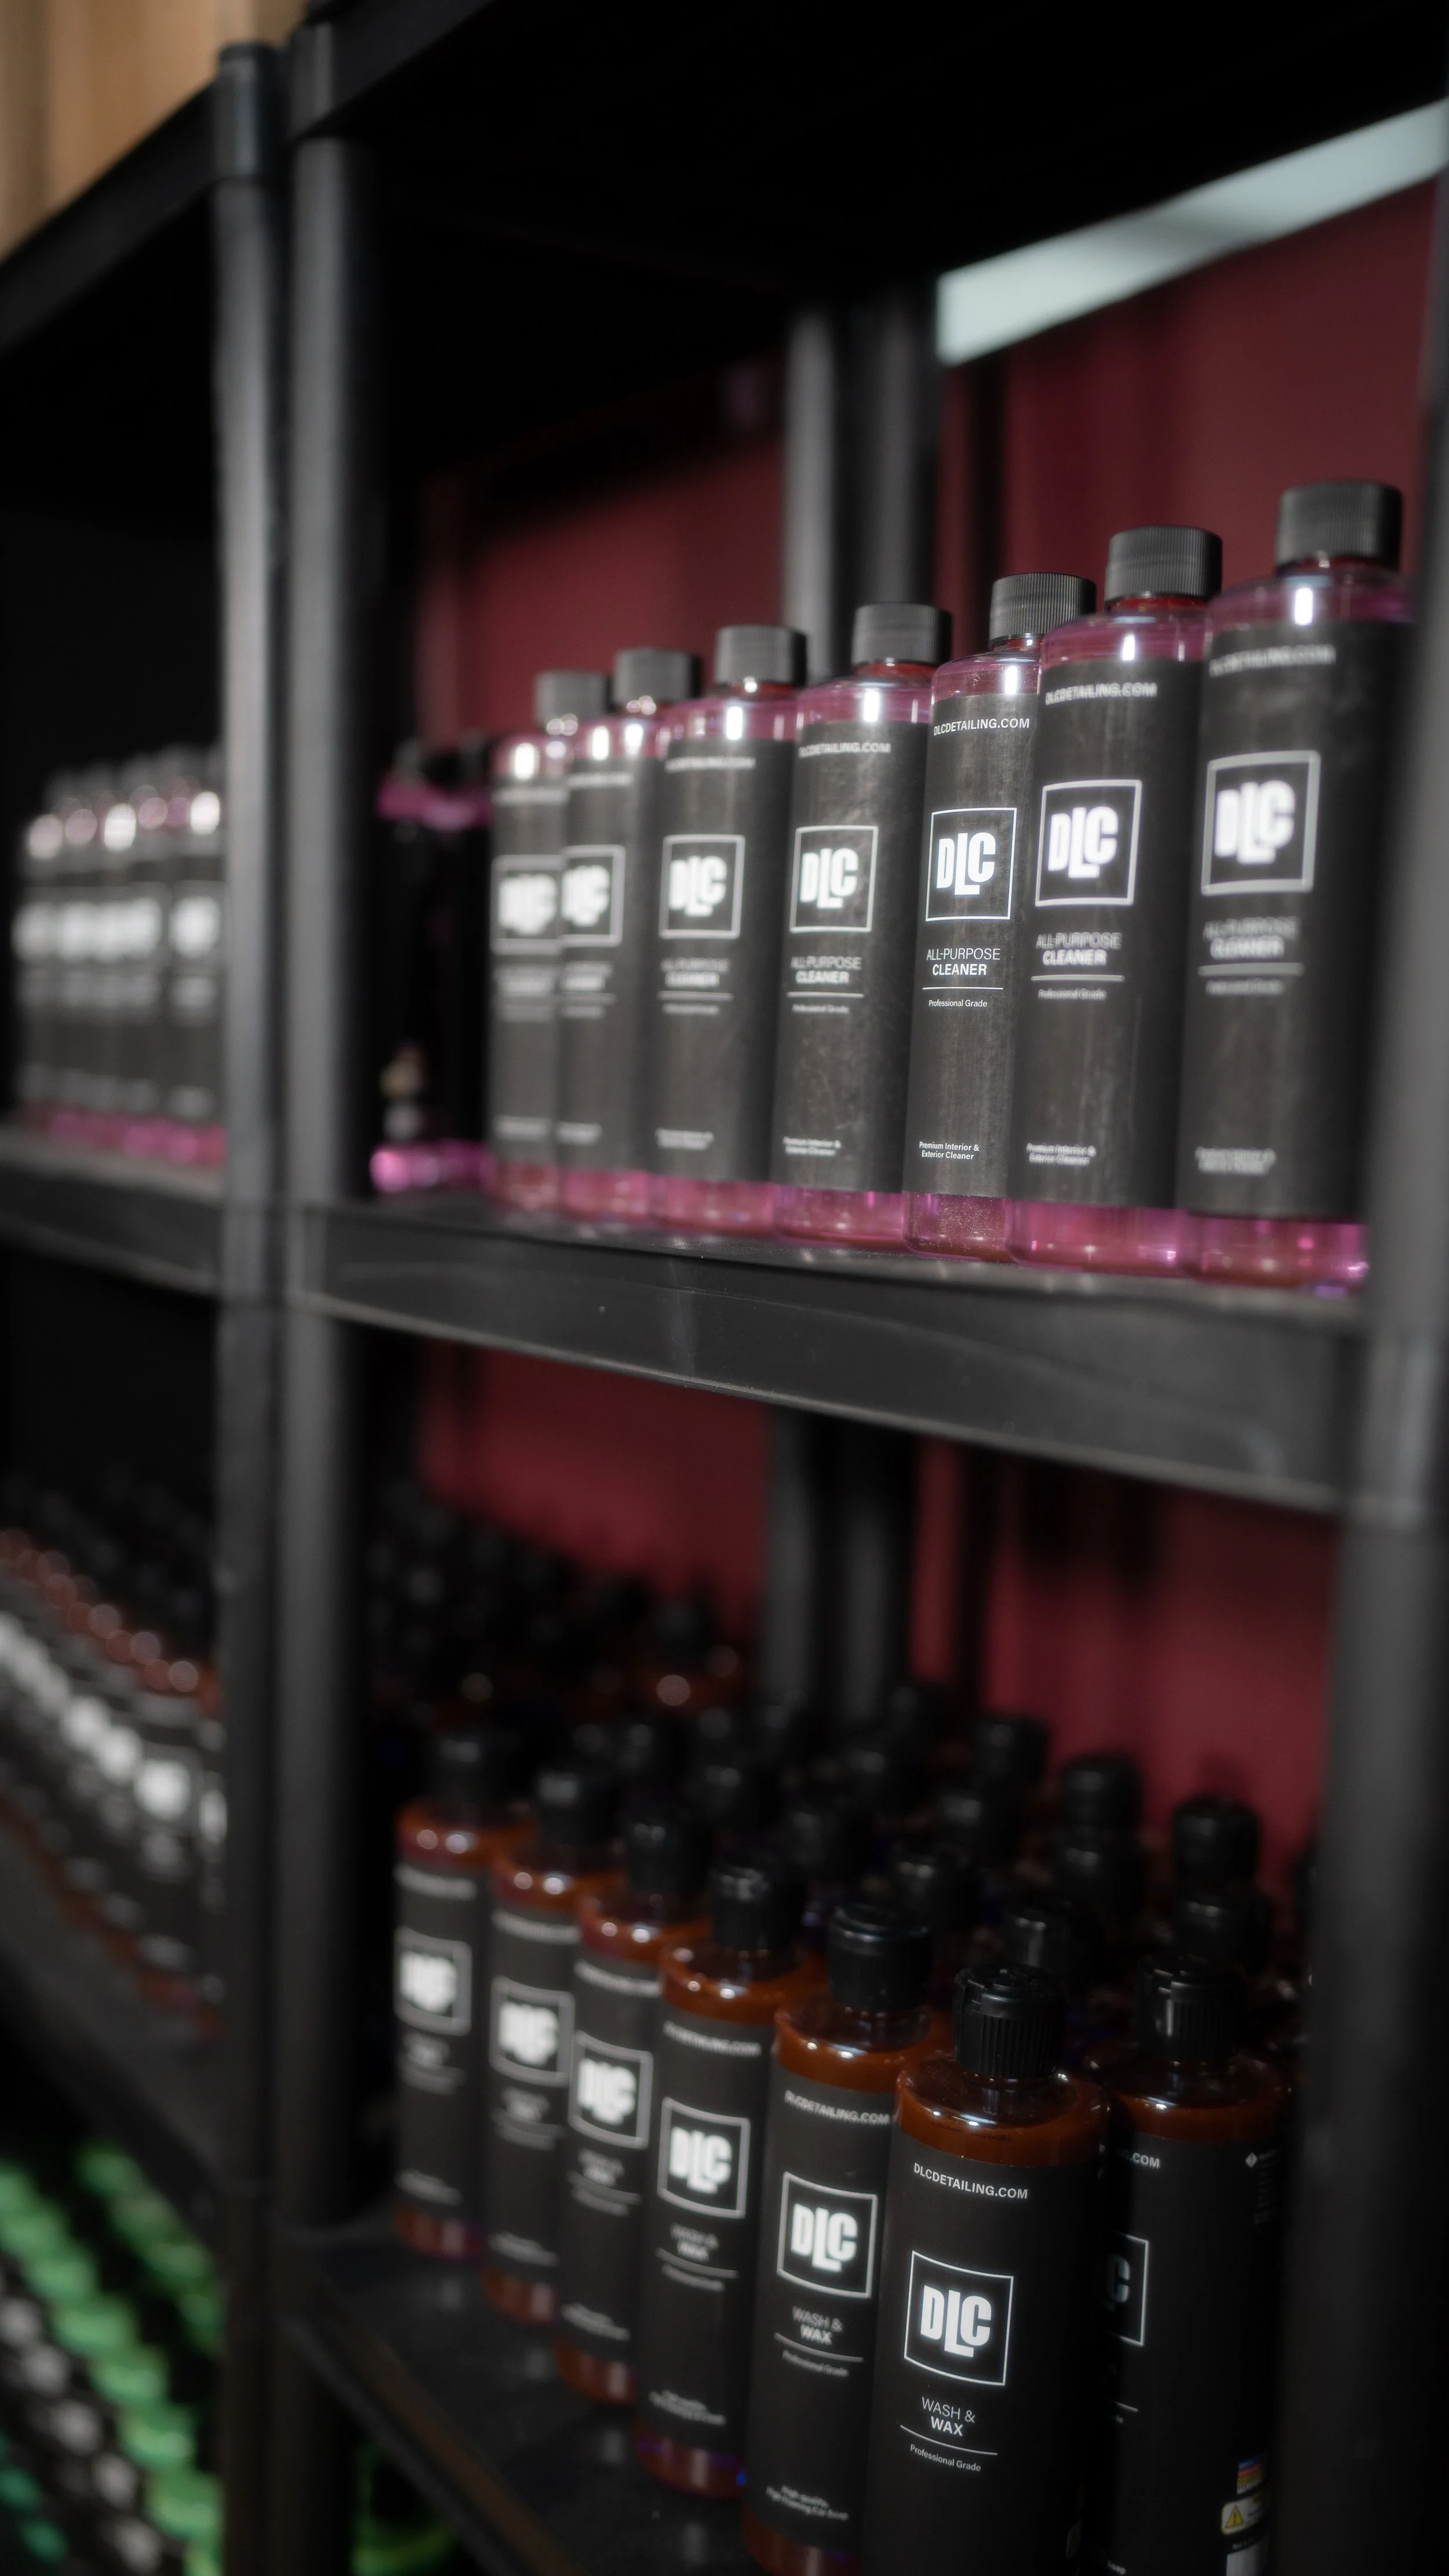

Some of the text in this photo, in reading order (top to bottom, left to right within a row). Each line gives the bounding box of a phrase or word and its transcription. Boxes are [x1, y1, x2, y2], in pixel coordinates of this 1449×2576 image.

[1046, 682, 1158, 705] DLCDETAILING.COM
[934, 718, 1030, 736] DLCDETAILING.COM
[1214, 780, 1295, 864] DLC
[1048, 806, 1119, 878] DLC
[937, 832, 996, 895] DLC
[669, 856, 727, 917] DLC
[800, 848, 858, 909] DLC
[1036, 932, 1122, 949] ALL-PURPOSE
[926, 948, 1000, 960] ALL-PURPOSE
[1043, 949, 1107, 966] CLEANER
[932, 964, 987, 975] CLEANER
[929, 999, 963, 1007] Professional
[919, 1141, 944, 1149] Premium
[945, 1142, 972, 1151] Interior
[922, 1150, 974, 1160] Exterior Cleaner
[669, 2126, 732, 2193] DLC
[913, 2162, 1028, 2199] DLCDETAILING.COM
[791, 2203, 858, 2273] DLC
[920, 2285, 992, 2357] DLC
[800, 2324, 833, 2345] WAX
[922, 2396, 975, 2423] WASH &
[931, 2415, 963, 2436] WAX
[910, 2443, 981, 2471] Professional Grade
